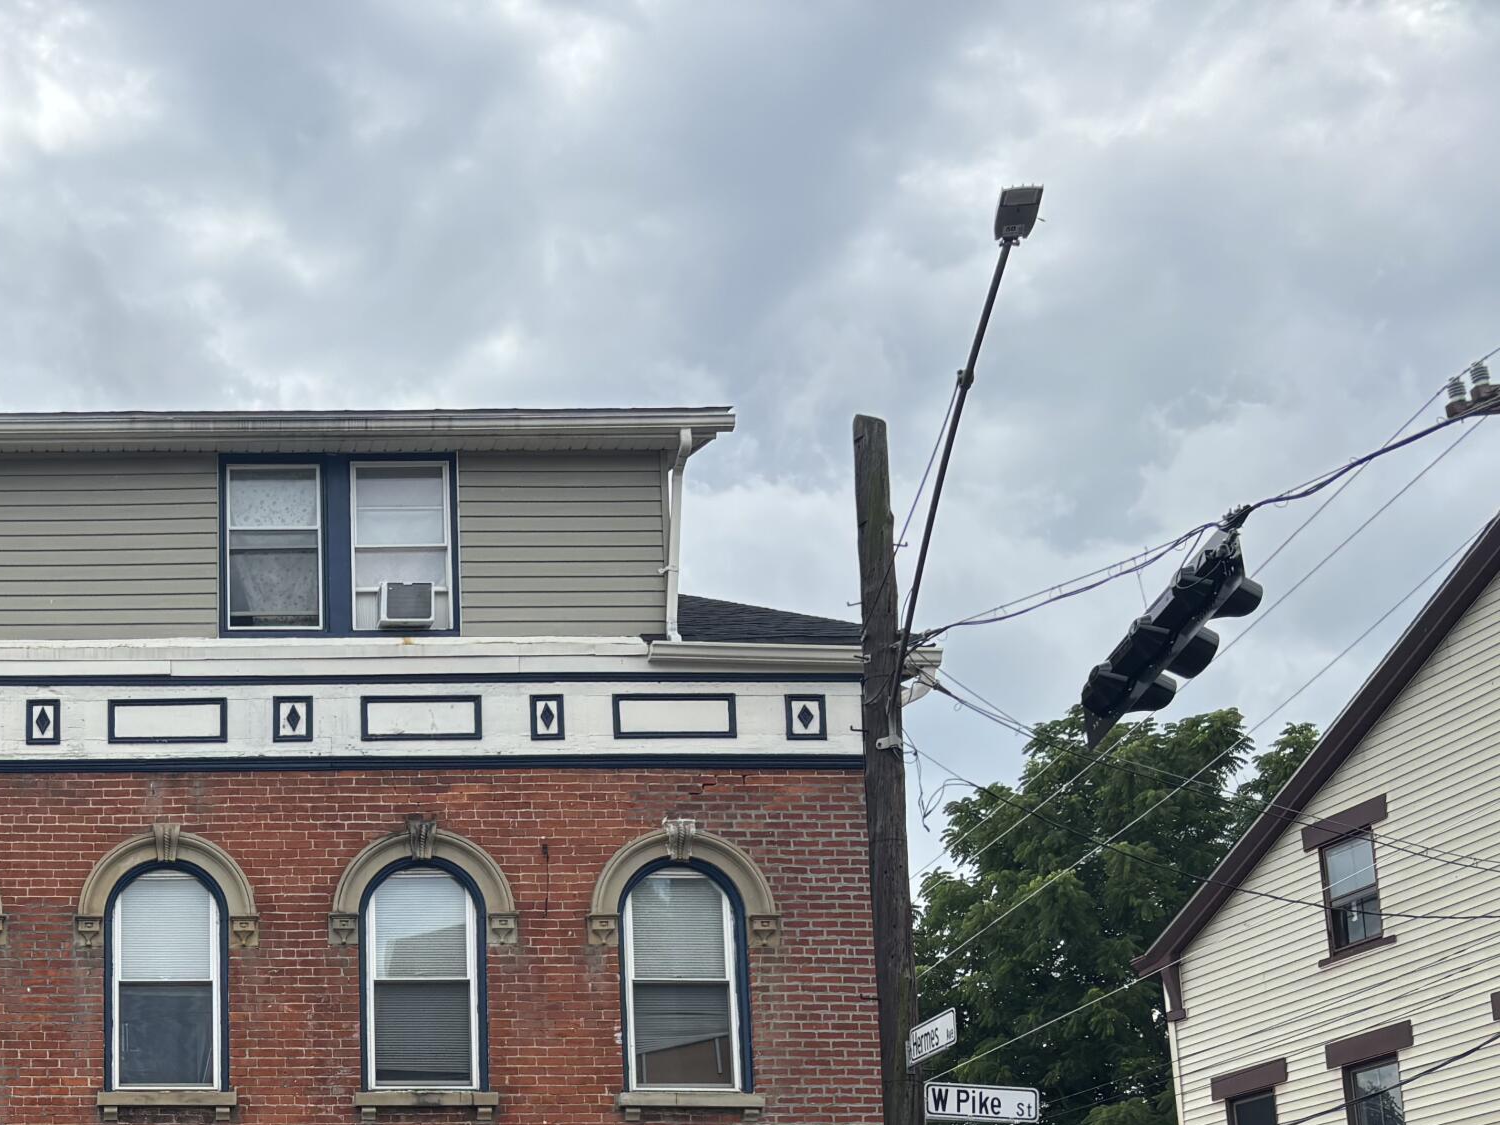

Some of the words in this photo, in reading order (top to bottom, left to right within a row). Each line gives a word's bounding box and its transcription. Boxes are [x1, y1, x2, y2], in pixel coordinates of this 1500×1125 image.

[912, 1026, 939, 1057] Hermes
[946, 1028, 954, 1041] Ave
[931, 1088, 949, 1112] W
[956, 1089, 1002, 1115] Pike
[1016, 1102, 1032, 1117] St
